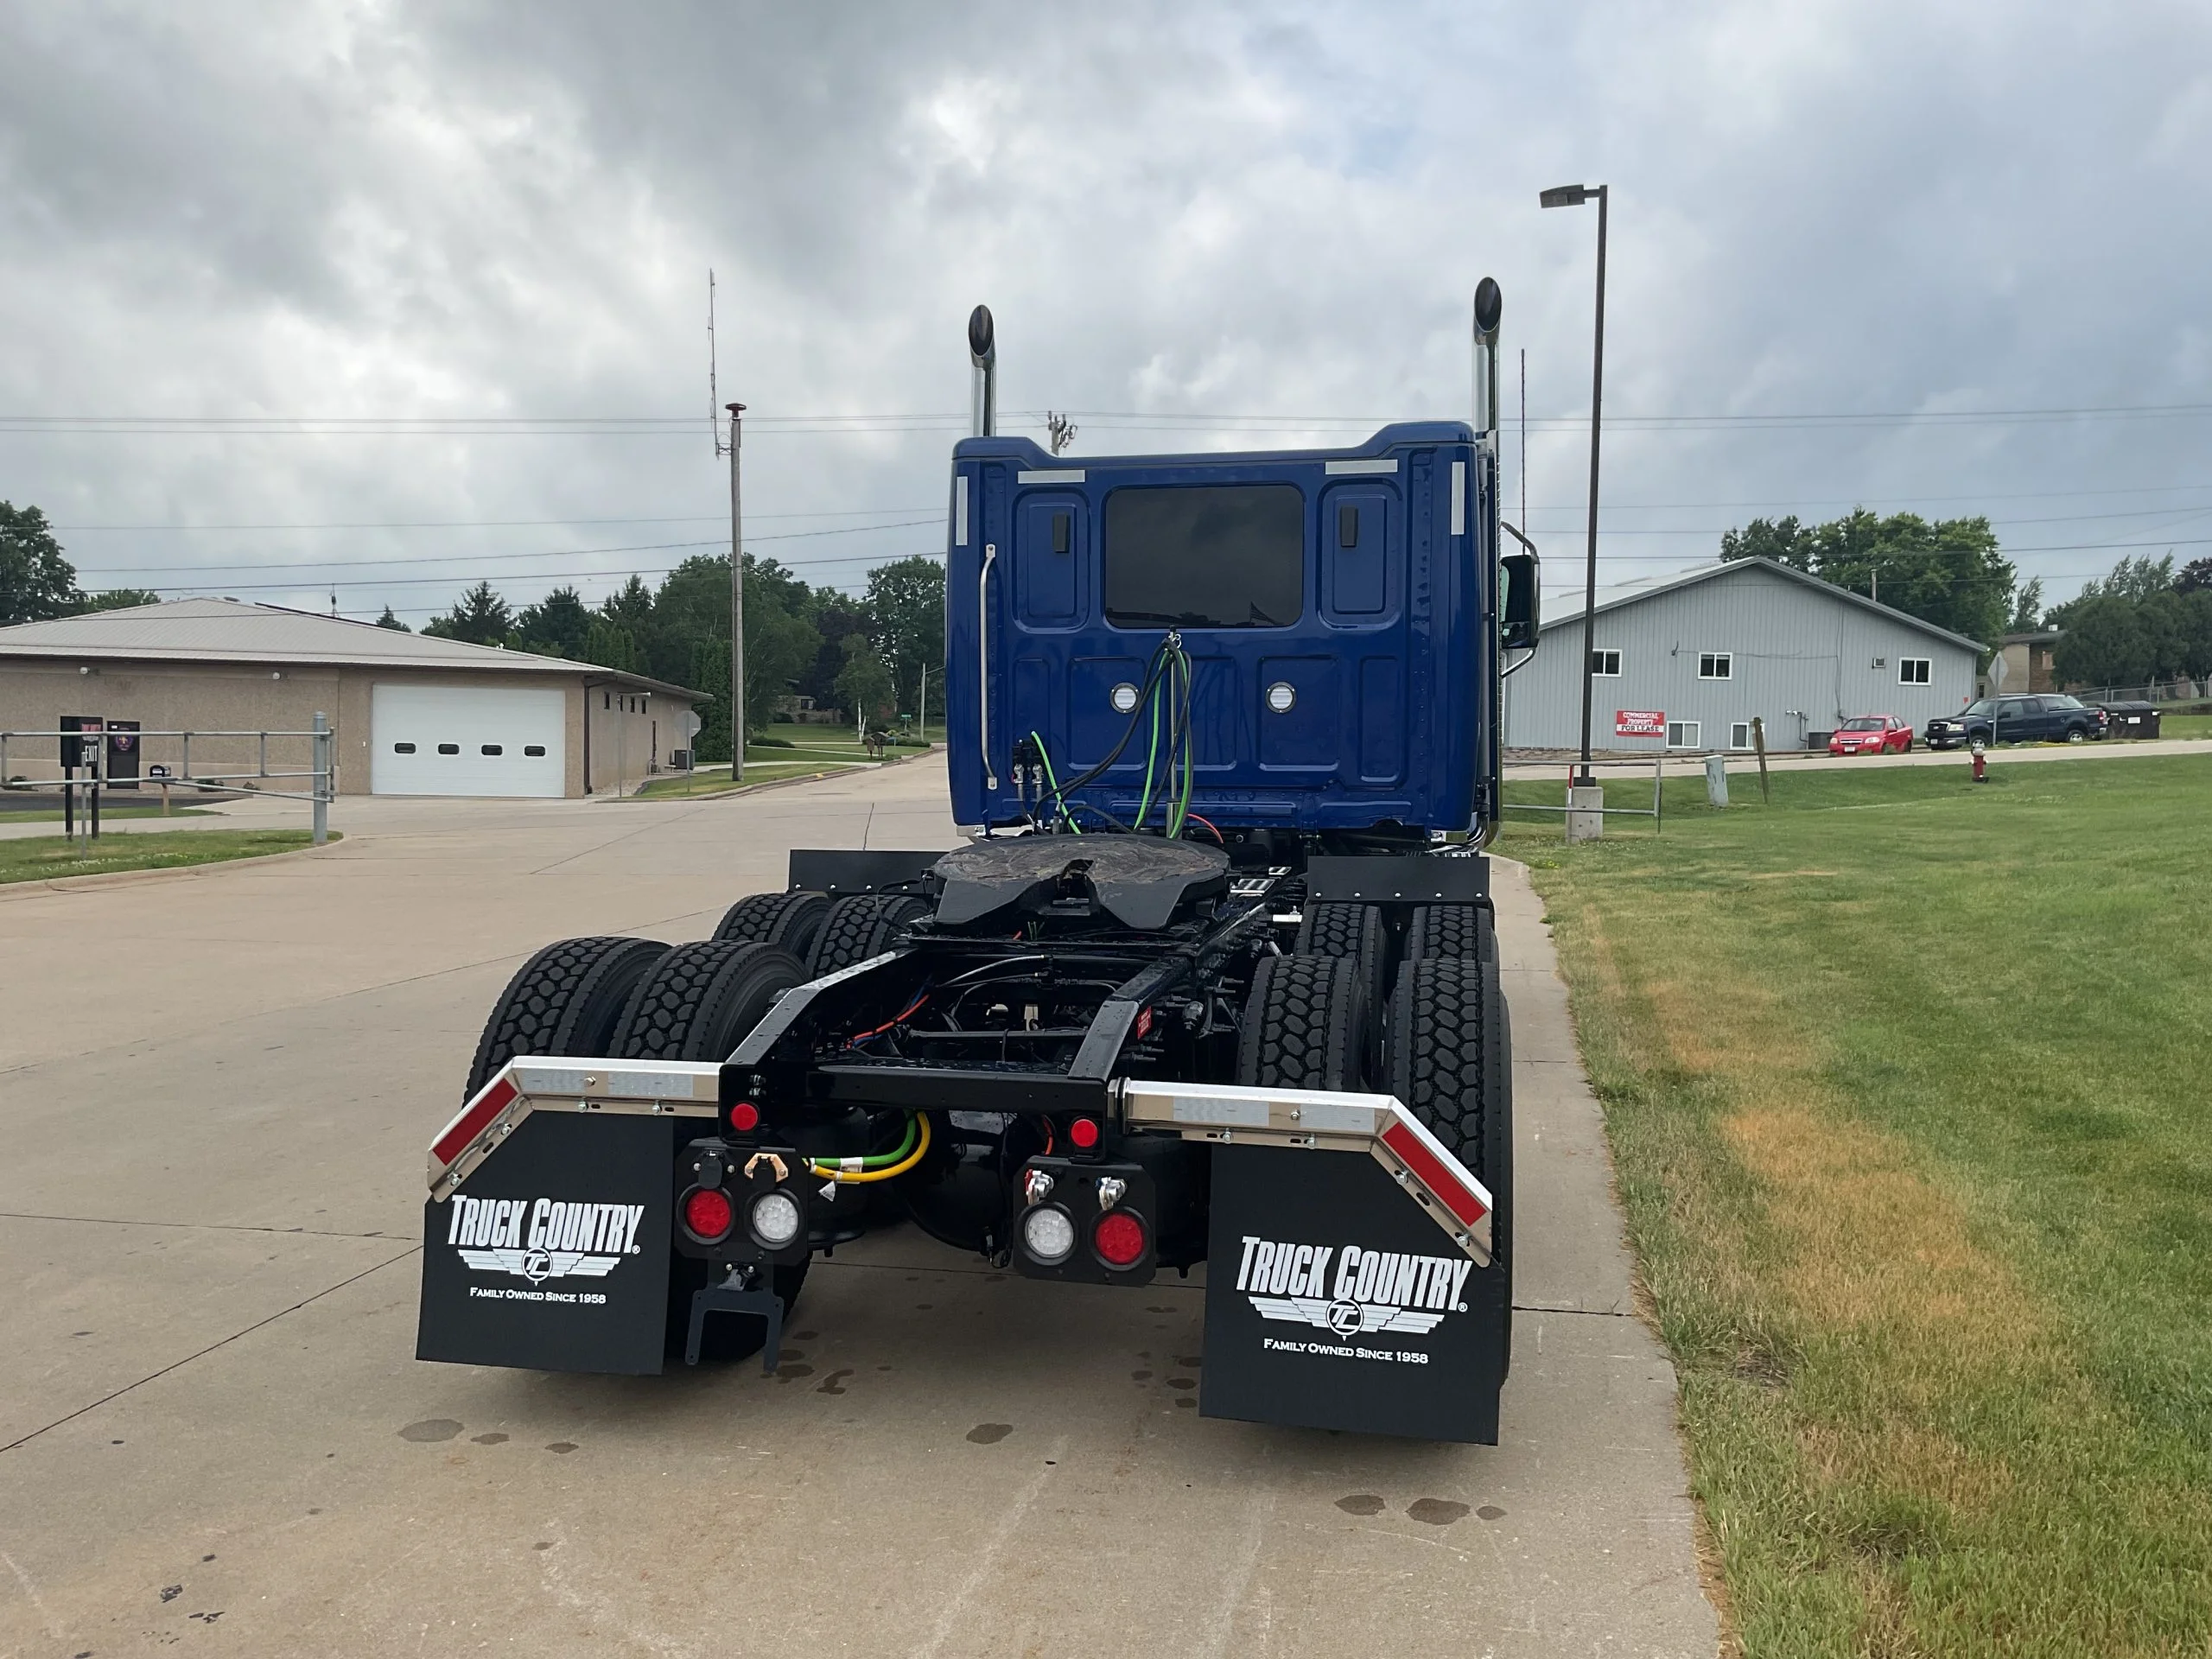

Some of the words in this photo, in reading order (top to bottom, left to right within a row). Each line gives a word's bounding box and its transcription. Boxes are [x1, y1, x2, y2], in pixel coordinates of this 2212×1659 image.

[85, 745, 98, 762] EXIT
[448, 1194, 528, 1248] TRUCK
[1236, 1236, 1334, 1299] TRUCK
[469, 1287, 505, 1300] FAMILY
[505, 1288, 544, 1302] OWNED
[545, 1291, 577, 1303] SINCE
[578, 1293, 607, 1305] 1958
[1263, 1338, 1307, 1353] FAMILY
[1307, 1342, 1355, 1357] OWNED
[1355, 1346, 1394, 1362] SINCE
[1395, 1351, 1429, 1365] 1958
